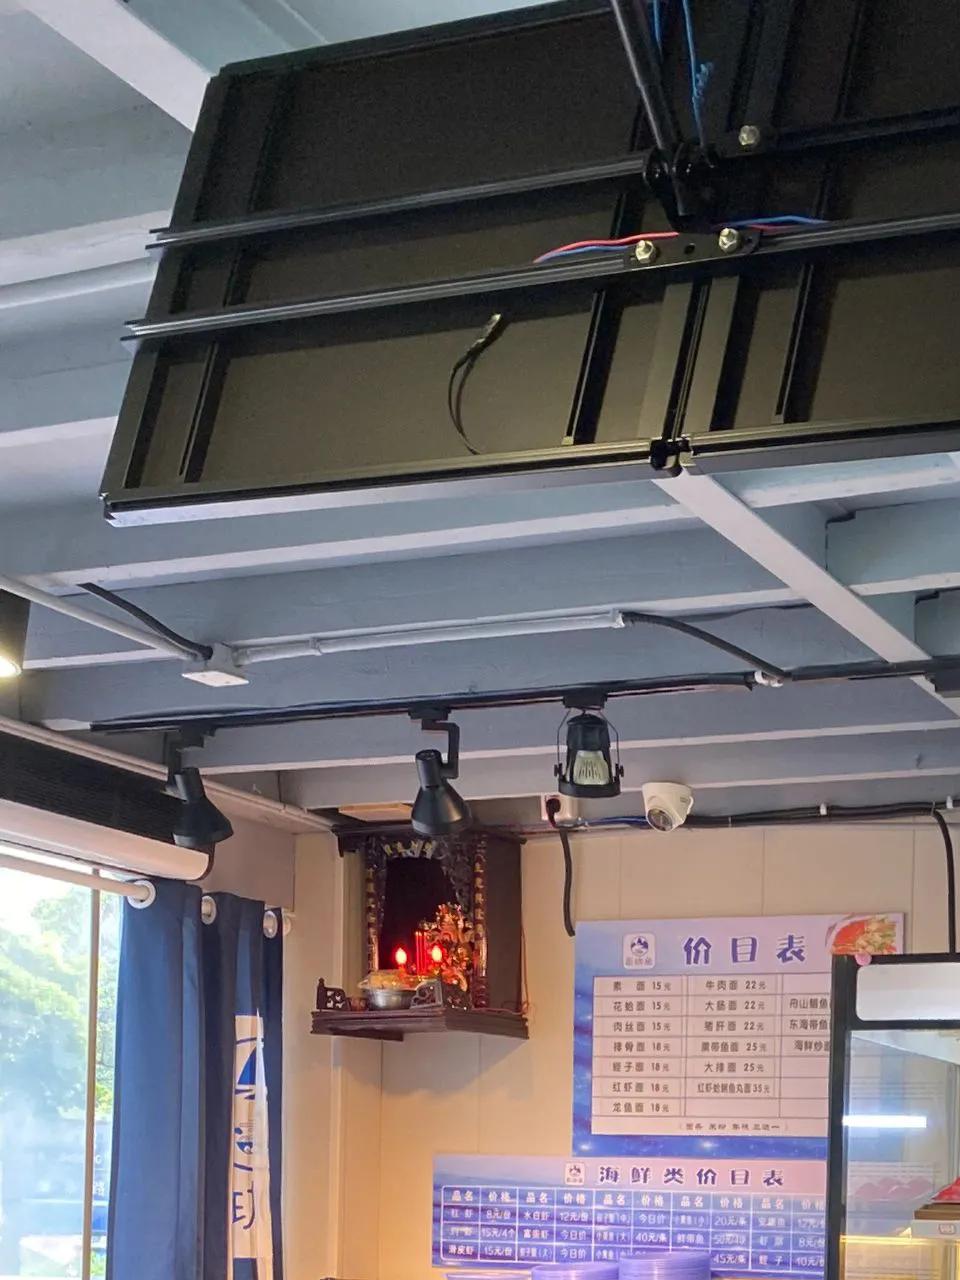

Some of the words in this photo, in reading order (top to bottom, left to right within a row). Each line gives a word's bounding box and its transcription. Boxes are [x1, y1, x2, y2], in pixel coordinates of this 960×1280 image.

[684, 935, 806, 965] 价目表
[652, 981, 671, 991] 15元
[705, 980, 738, 990] 牛肉面
[745, 980, 766, 990] 22元
[613, 1001, 645, 1012] 花蛤面
[652, 1001, 671, 1011] 15元
[705, 1000, 737, 1011] 大肠面
[744, 1000, 765, 1010] 22元
[613, 1021, 645, 1032] 肉丝面
[652, 1021, 671, 1031] 15元
[704, 1021, 736, 1031] 猪肝面
[744, 1021, 764, 1031] 22元
[790, 1019, 831, 1030] 东海带鱼
[613, 1042, 645, 1052] 排骨面
[746, 1042, 767, 1052] 25元
[651, 1062, 670, 1072] 18元
[704, 1062, 736, 1073] 大排面
[743, 1063, 764, 1072] 25元
[612, 1082, 644, 1092] 红虾面
[651, 1083, 670, 1093] 18元
[600, 1166, 784, 1187] 海鲜类价目表
[451, 1190, 473, 1202] 品名
[488, 1191, 511, 1202] 价格
[526, 1191, 548, 1203] 品名
[564, 1192, 586, 1205] 价格
[603, 1194, 625, 1206] 品名
[642, 1194, 664, 1207] 价格
[681, 1196, 704, 1208] 品名
[720, 1197, 743, 1208] 价格
[762, 1198, 784, 1210] 品名
[639, 1214, 666, 1224] 今日价
[560, 1230, 587, 1240] 今日价
[560, 1248, 587, 1259] 今日价
